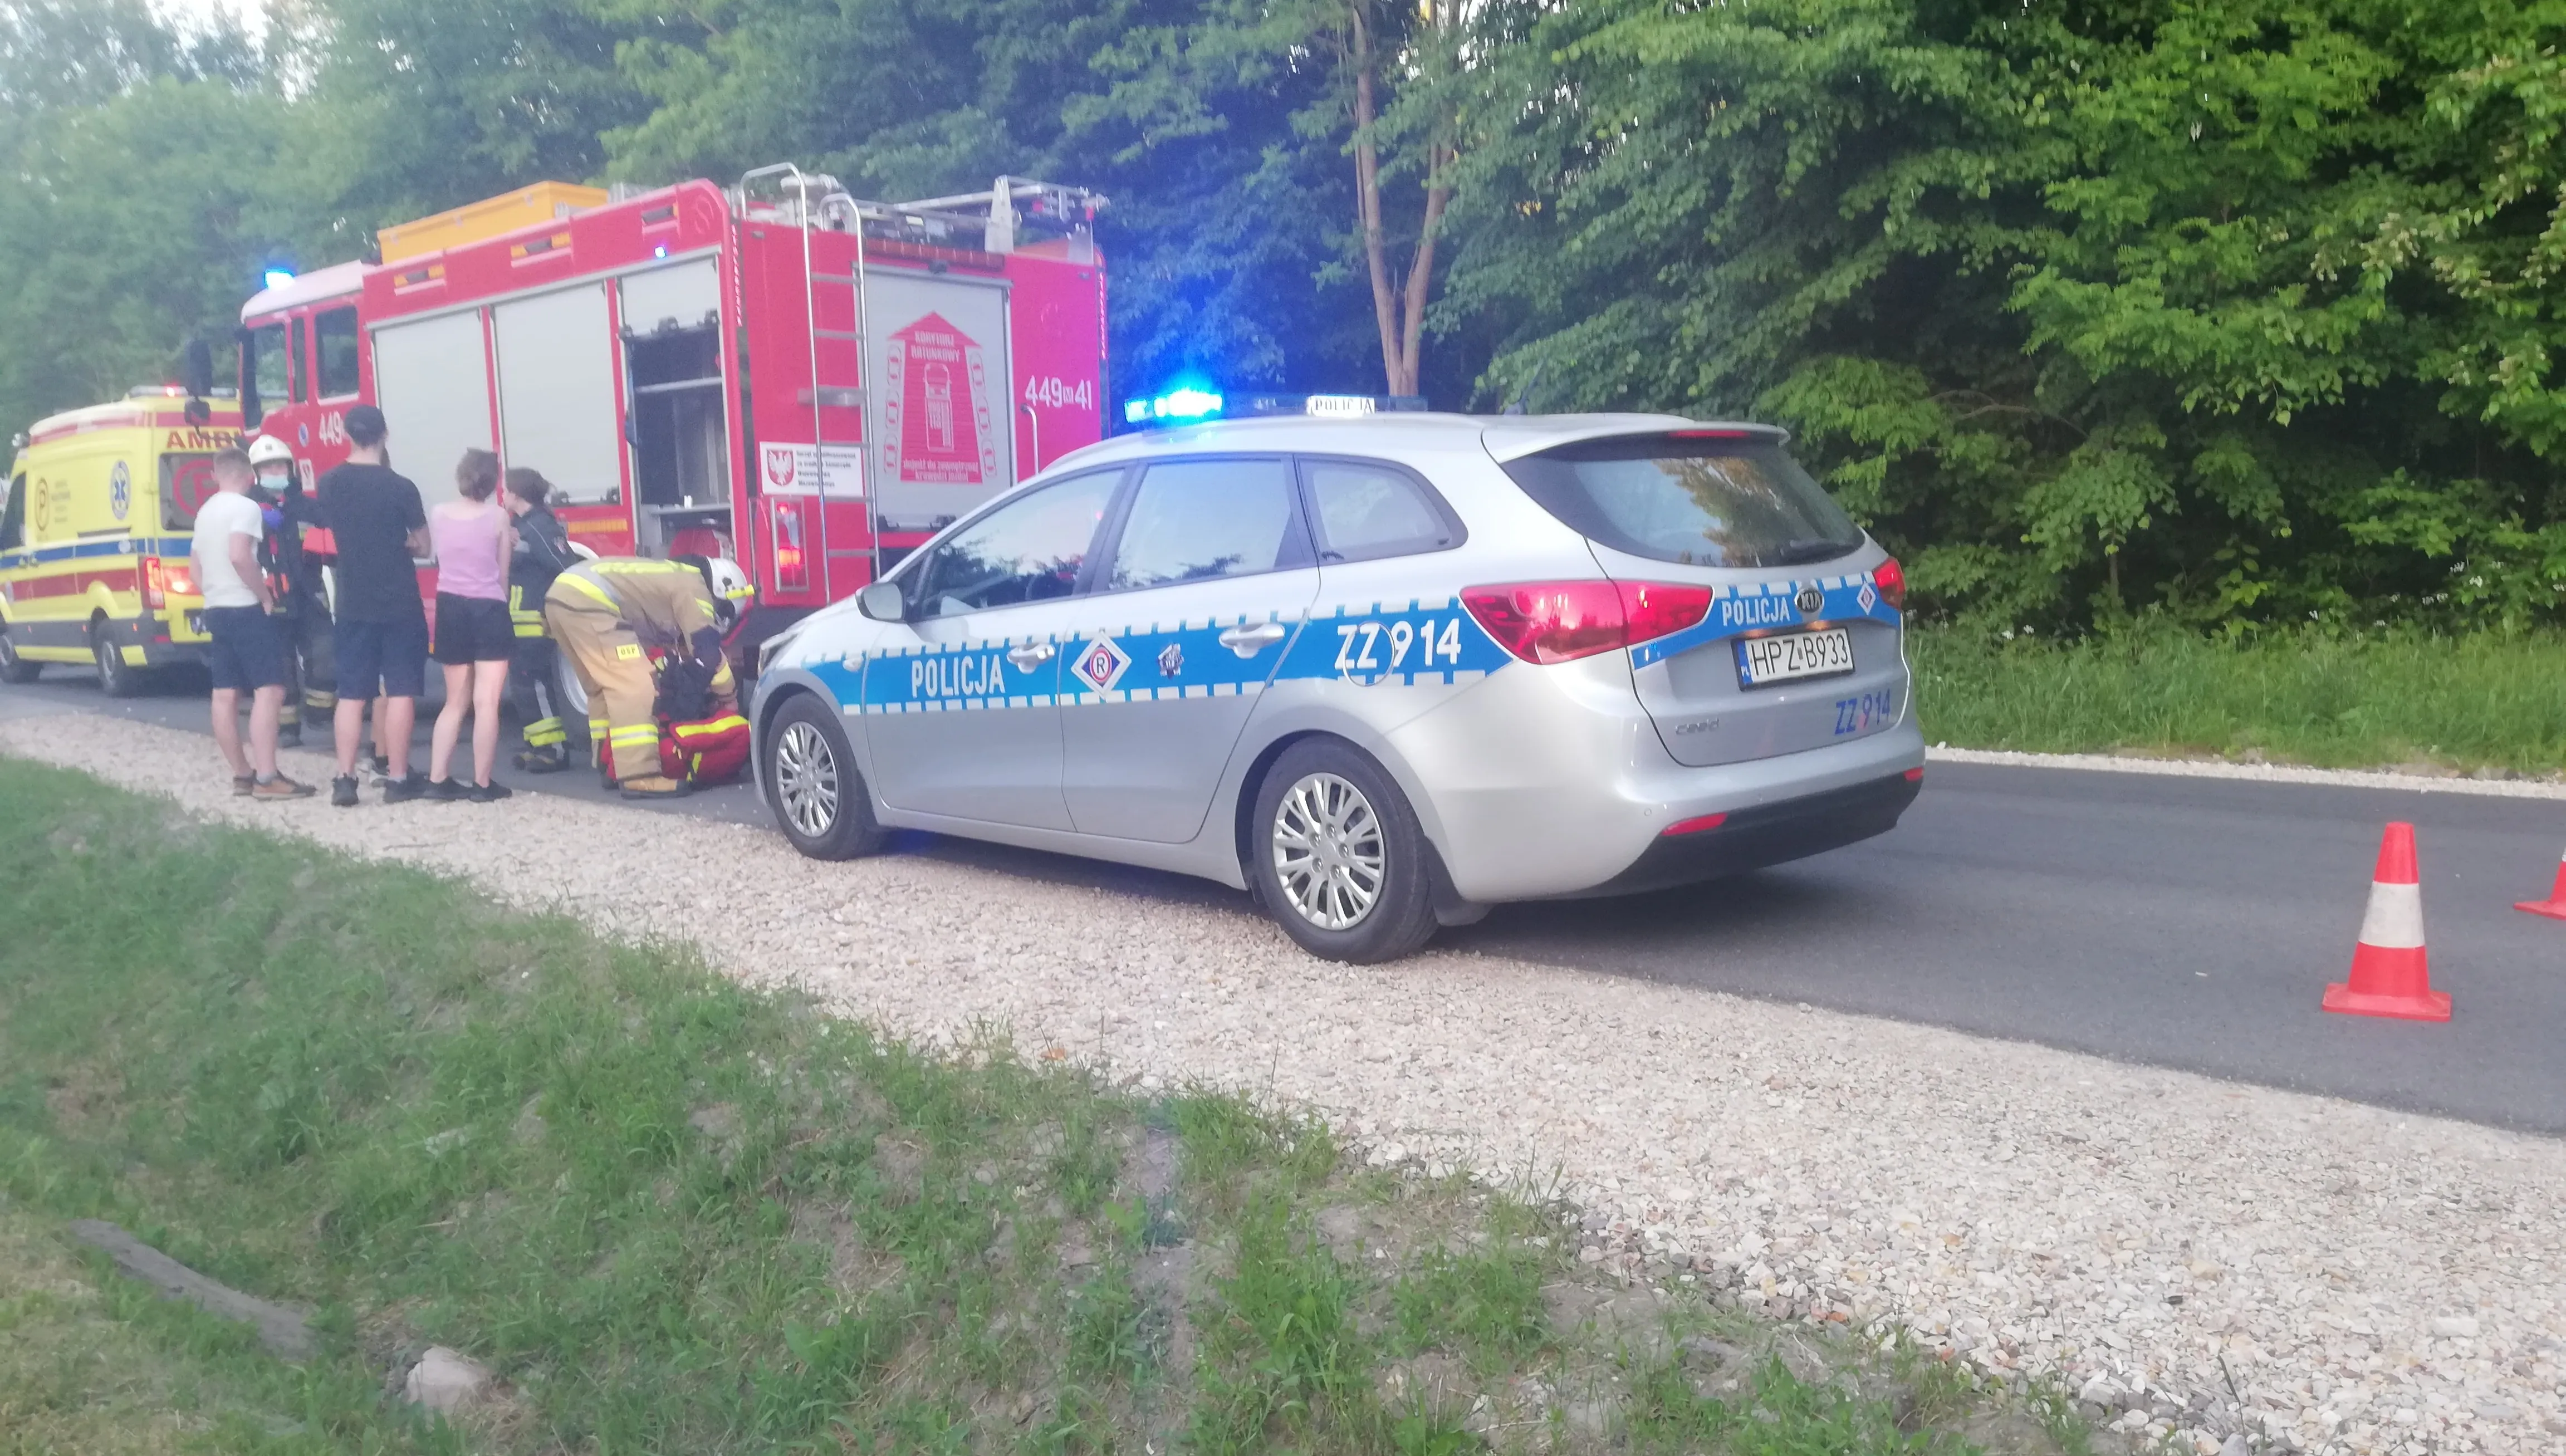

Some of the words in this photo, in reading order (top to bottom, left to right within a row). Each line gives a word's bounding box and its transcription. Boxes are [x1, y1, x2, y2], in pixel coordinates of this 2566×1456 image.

[1315, 397, 1373, 414] POLICJA
[1721, 597, 1790, 627] POLICJA
[1801, 592, 1821, 610] KIA
[1335, 622, 1383, 669] ZZ
[1392, 618, 1462, 671] 914
[1751, 639, 1800, 676] HPZ
[1803, 634, 1848, 668] B933
[911, 654, 1005, 698] POLICJA
[1096, 656, 1105, 674] R
[1834, 697, 1858, 734] ZZ
[1862, 688, 1890, 728] 914
